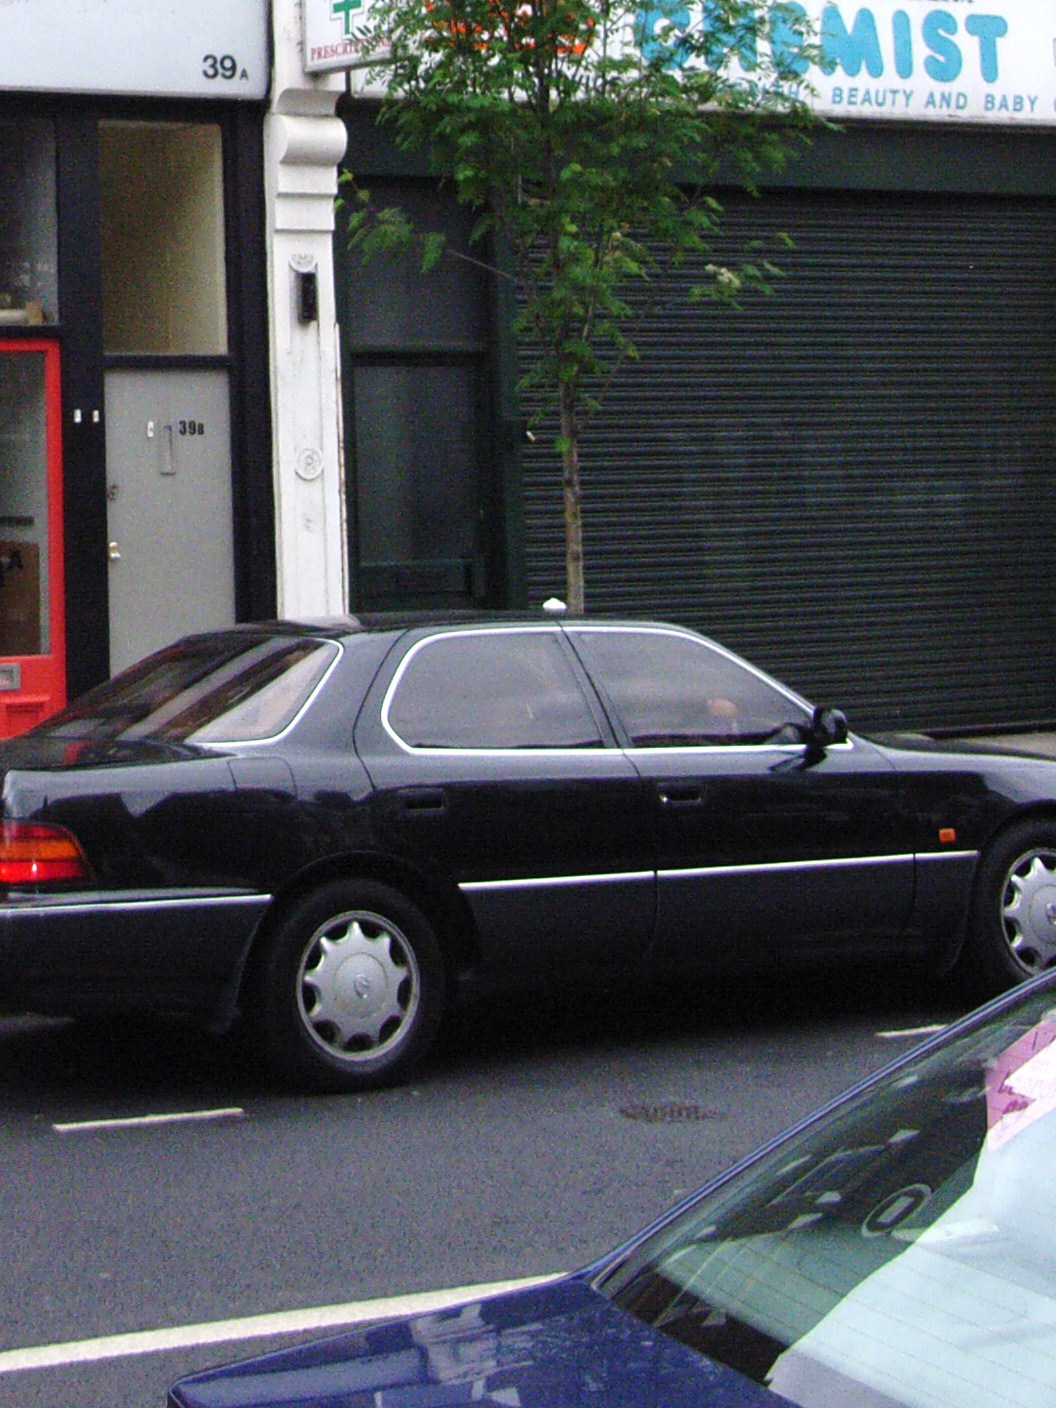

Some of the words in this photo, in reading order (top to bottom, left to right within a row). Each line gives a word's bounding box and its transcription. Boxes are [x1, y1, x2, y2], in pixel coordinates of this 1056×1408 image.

[832, 86, 914, 108] BEAUTY
[924, 91, 968, 109] AND
[984, 93, 1038, 112] BABY
